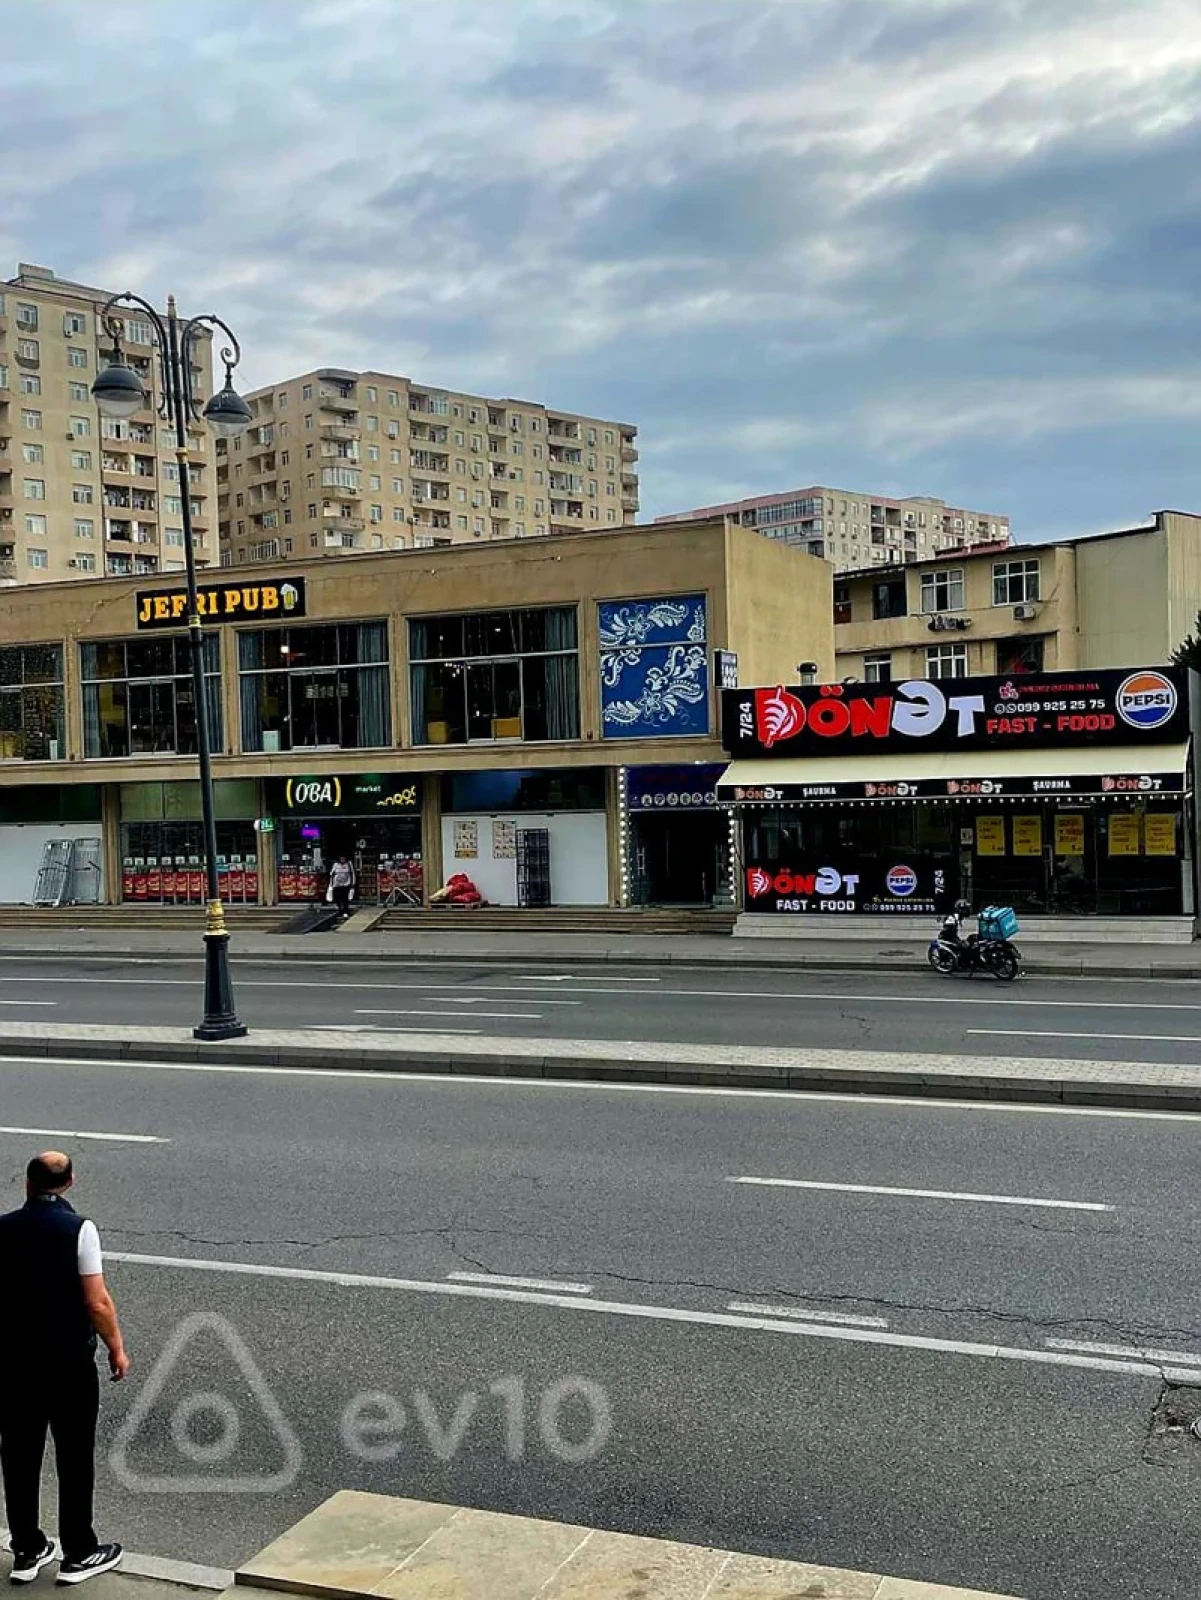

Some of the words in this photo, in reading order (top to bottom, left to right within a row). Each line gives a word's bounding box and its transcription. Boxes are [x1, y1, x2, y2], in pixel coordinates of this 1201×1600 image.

[139, 592, 219, 622] JEFRI
[224, 586, 279, 613] PUB
[1017, 702, 1040, 712] 099
[1043, 701, 1067, 711] 925
[1069, 700, 1086, 710] 25
[1089, 699, 1105, 709] 75
[1122, 692, 1170, 707] PEPSI
[739, 701, 753, 738] 7/24
[755, 681, 985, 748] DÖNƏT
[986, 717, 1037, 734] FAST
[1057, 714, 1116, 732] FOOD
[934, 870, 945, 894] 7/24
[776, 900, 808, 911] FAST
[820, 900, 855, 911] FOOD
